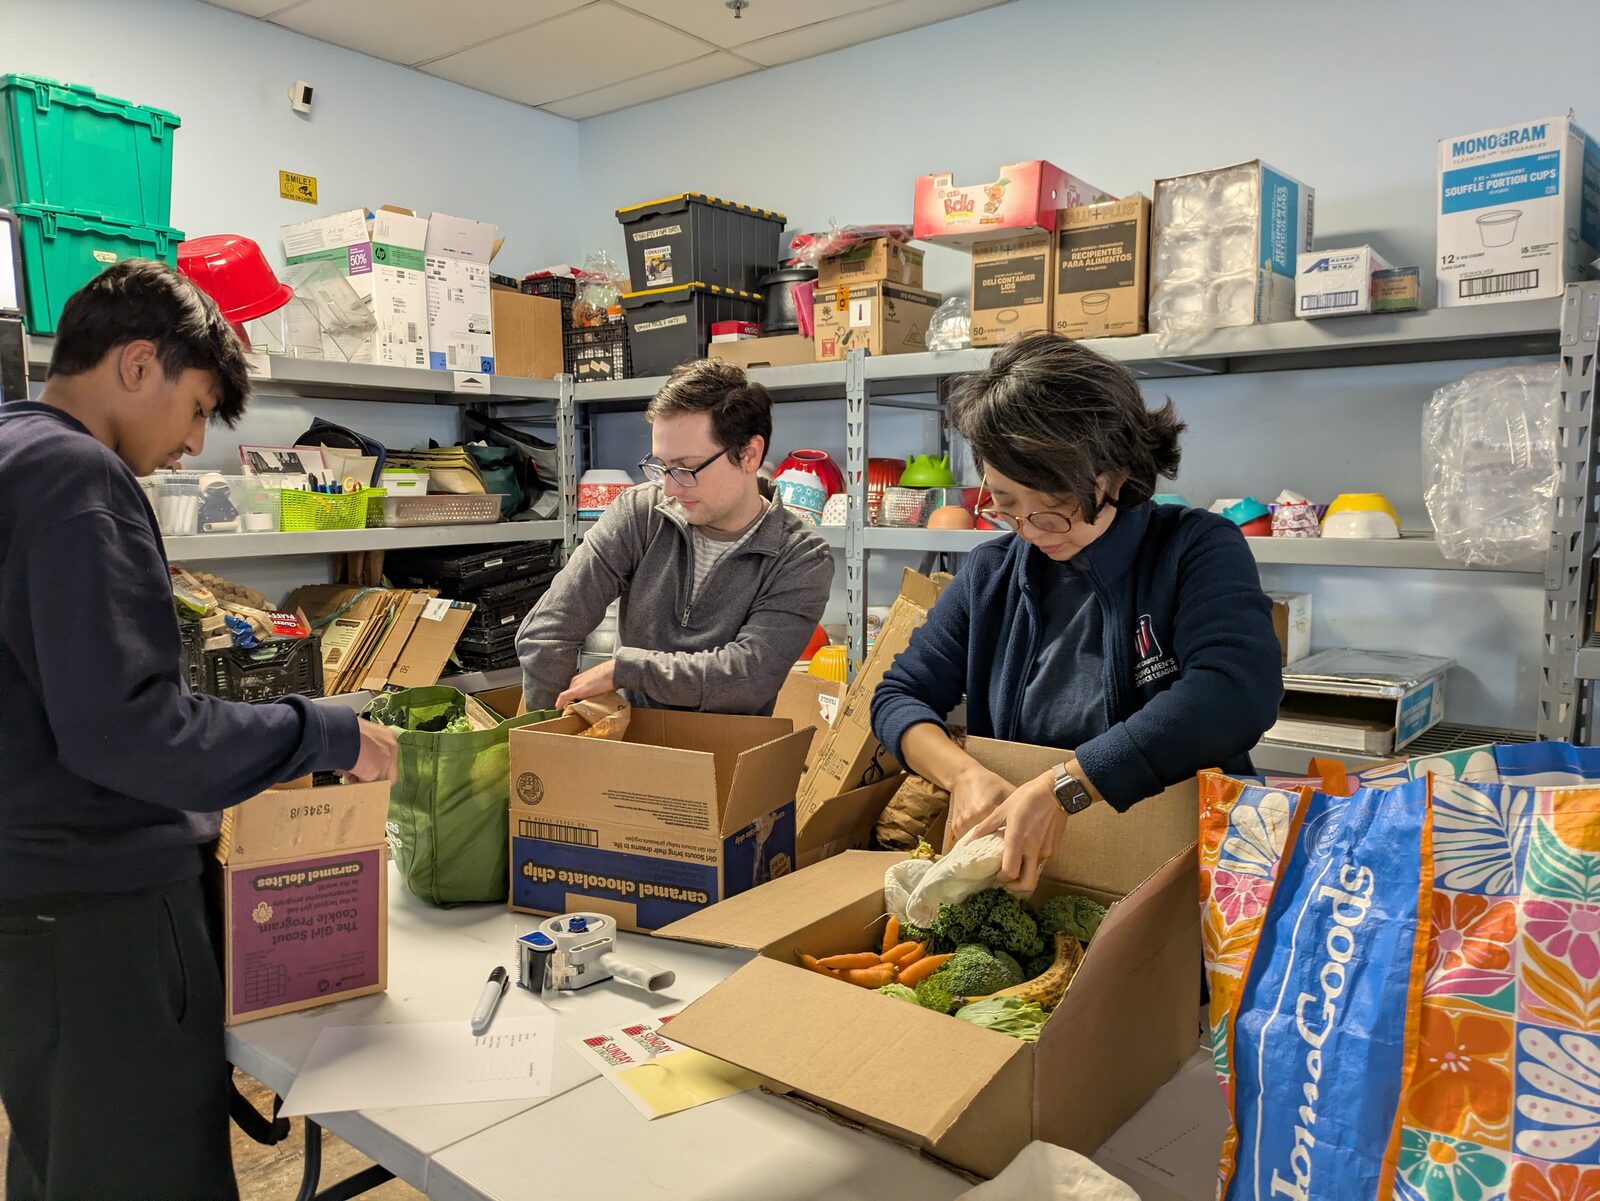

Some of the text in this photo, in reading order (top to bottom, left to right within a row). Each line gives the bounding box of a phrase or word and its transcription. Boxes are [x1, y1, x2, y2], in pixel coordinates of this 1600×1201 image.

[1452, 124, 1546, 157] MONOGRAM
[286, 174, 311, 186] SMILE!
[1444, 182, 1485, 197] SOUFFLE
[1486, 174, 1527, 190] PORTION
[1529, 169, 1556, 182] CUPS
[943, 194, 975, 214] Bella
[350, 252, 367, 266] 50%
[375, 247, 387, 260] hp
[1071, 247, 1122, 260] RECIPIENTES
[1441, 255, 1455, 265] 12
[1062, 259, 1084, 269] PARA
[1085, 253, 1132, 266] ALIMENTOS
[982, 279, 996, 287] DELI
[997, 273, 1035, 285] CONTAINER
[973, 327, 984, 335] 50
[1057, 321, 1067, 329] 50
[1151, 657, 1175, 673] MEN'S
[1152, 665, 1178, 679] LEAGUE
[630, 843, 653, 854] dreams
[653, 847, 668, 856] their
[668, 848, 684, 859] bring
[684, 852, 705, 861] Scouts
[705, 855, 718, 863] Girl
[307, 864, 360, 882] caramel
[523, 862, 708, 905] caramel chocolate chip
[259, 908, 358, 933] Cookie Program
[272, 921, 358, 945] The Girl Scout
[602, 1042, 636, 1065] SUNDAY
